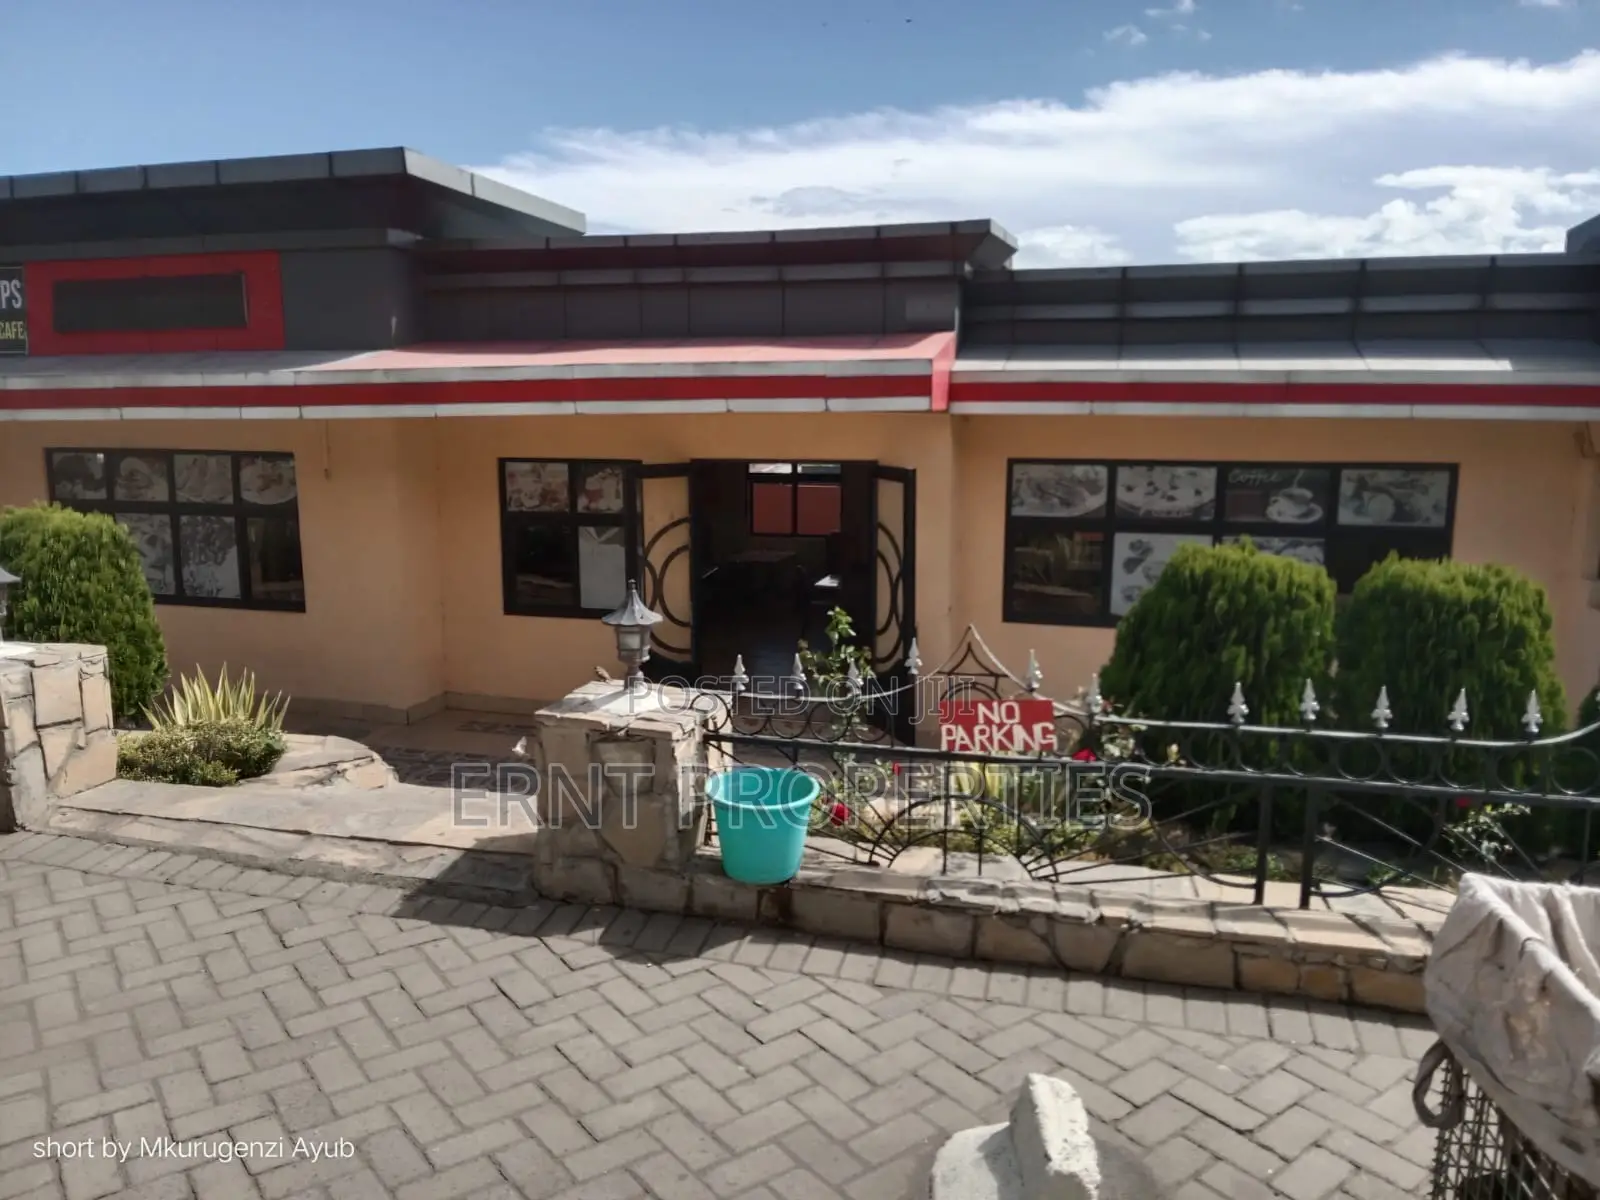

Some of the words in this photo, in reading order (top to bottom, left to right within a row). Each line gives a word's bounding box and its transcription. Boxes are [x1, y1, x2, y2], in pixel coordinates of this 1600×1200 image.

[0, 321, 24, 340] CAFE
[977, 701, 1021, 724] NO
[940, 722, 1059, 753] PARKING
